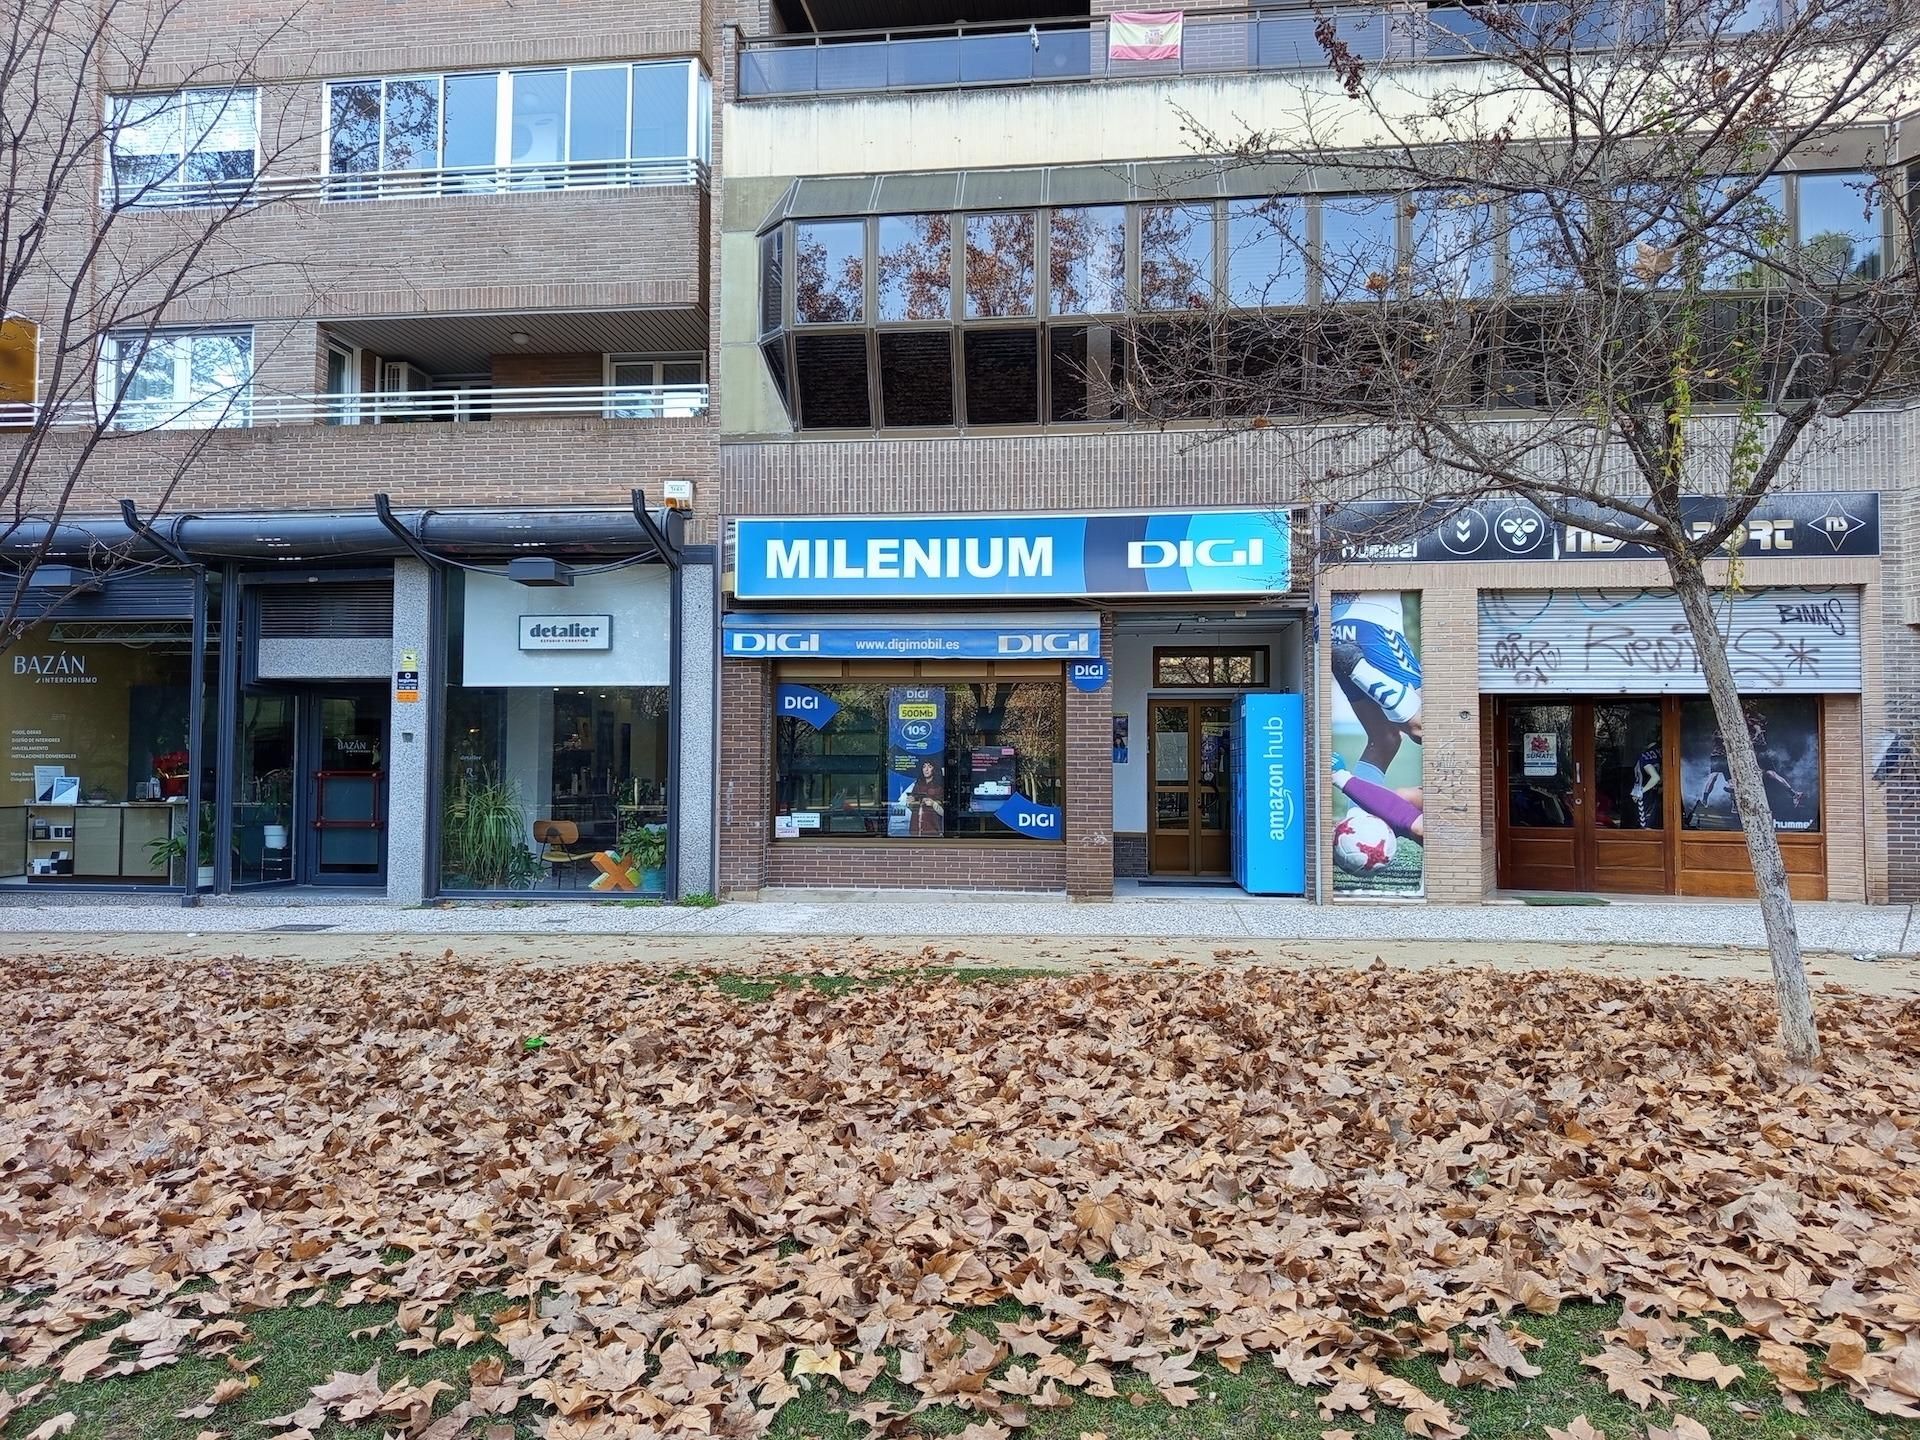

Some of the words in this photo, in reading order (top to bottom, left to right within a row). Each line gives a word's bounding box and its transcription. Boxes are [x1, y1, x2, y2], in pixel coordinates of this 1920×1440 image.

[766, 537, 1053, 579] MILENIUM
[1127, 538, 1264, 568] DIGI
[529, 623, 600, 638] detalier
[733, 633, 820, 652] DIGI
[855, 637, 960, 652] www.digimobil.es
[998, 633, 1089, 653] DIGI
[14, 650, 85, 674] BAZÁN
[1074, 664, 1104, 676] DIGI
[41, 676, 98, 684] INTERIORISMO
[907, 690, 929, 699] DIGI
[784, 696, 819, 710] DIGI
[902, 709, 934, 718] 500Mb
[1262, 716, 1283, 758] hub
[1269, 763, 1285, 841] amazon
[1018, 813, 1054, 827] DIGI
